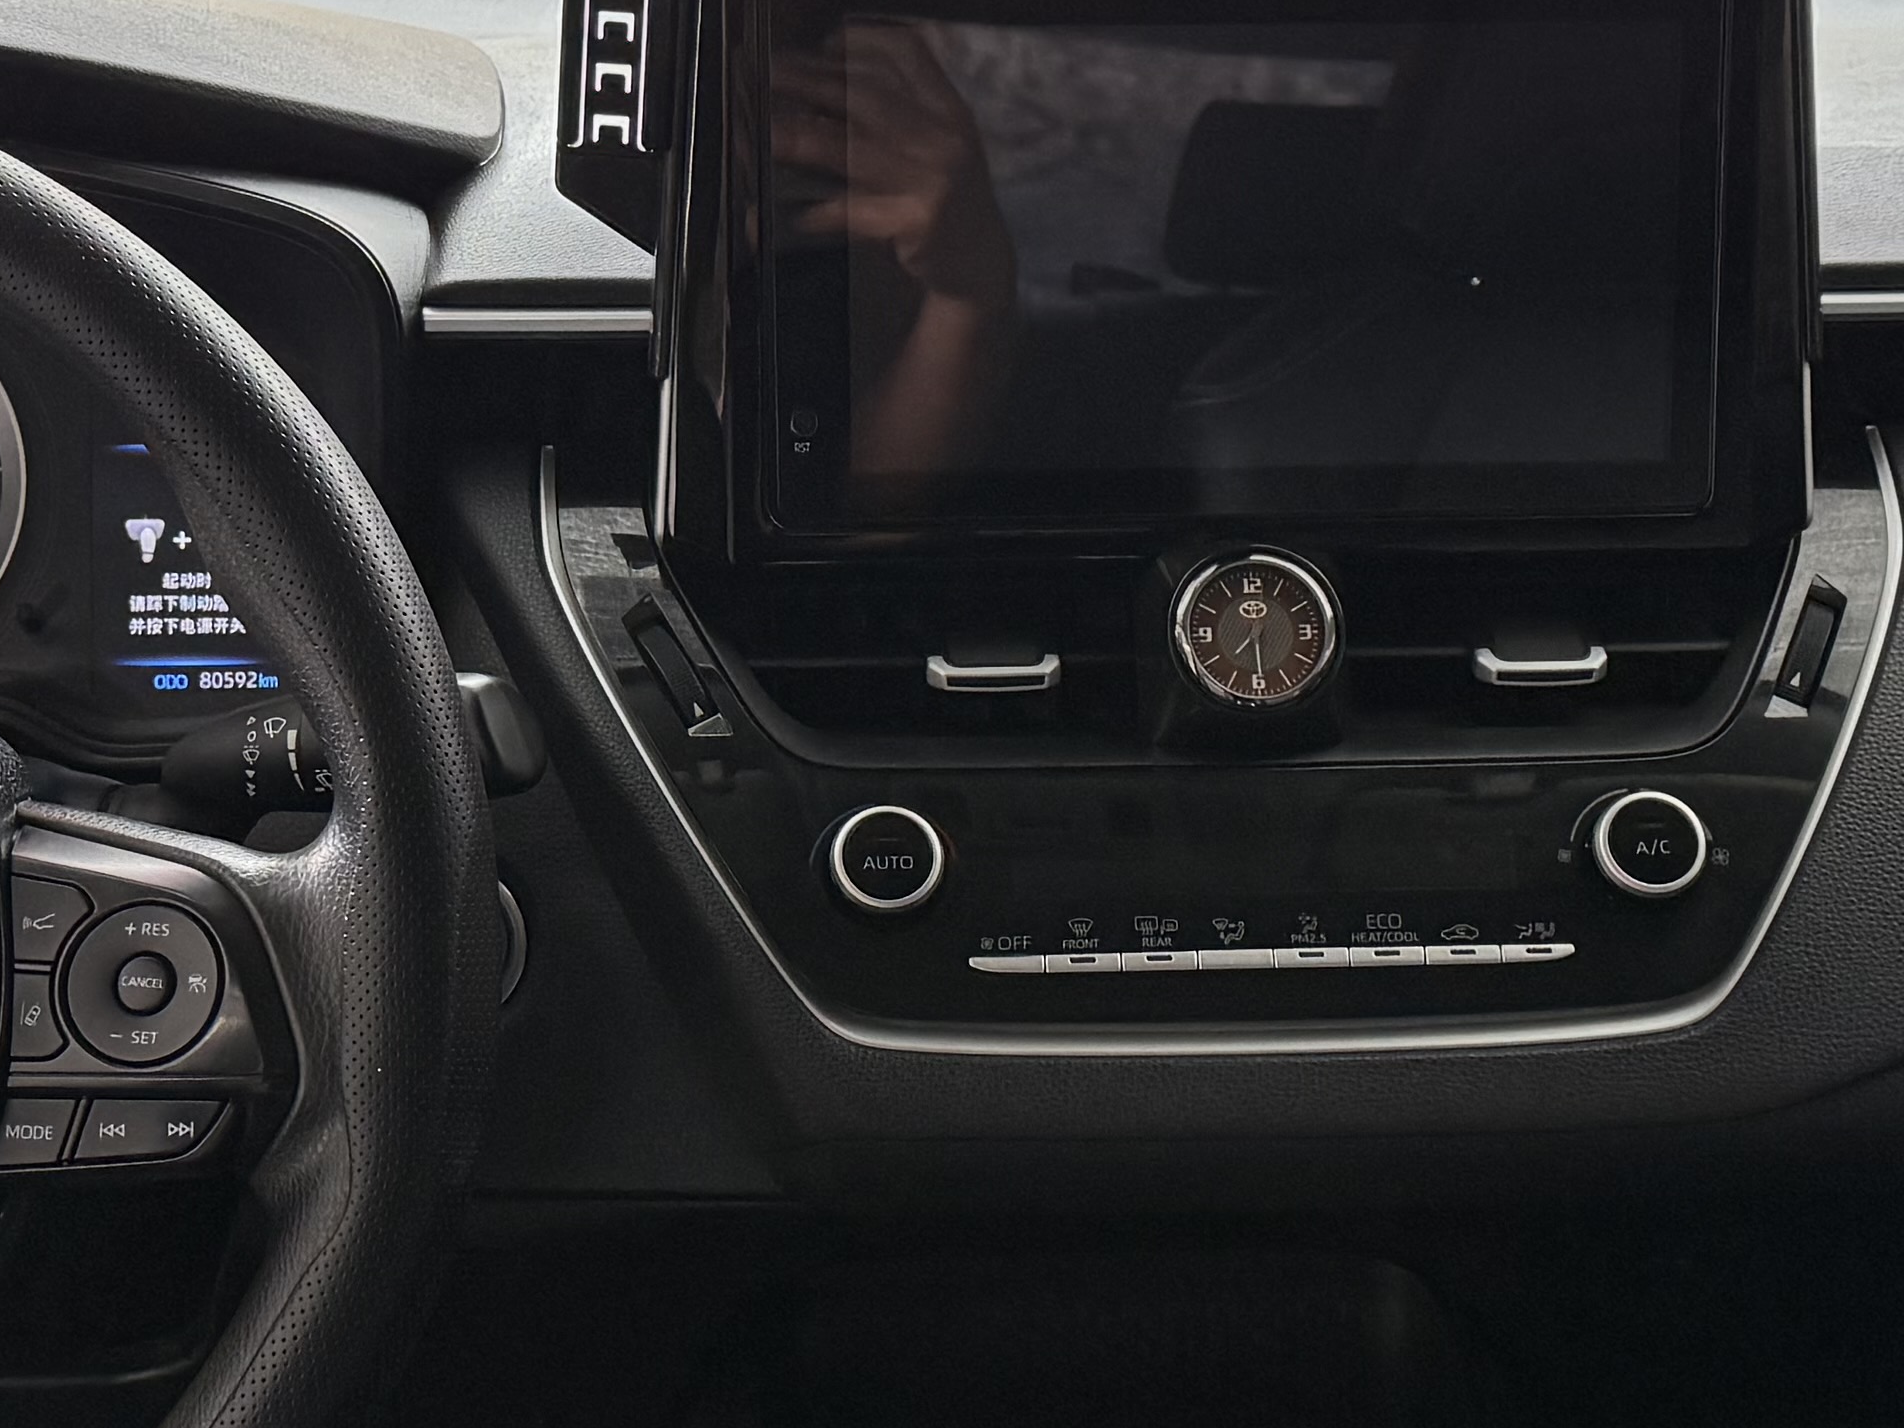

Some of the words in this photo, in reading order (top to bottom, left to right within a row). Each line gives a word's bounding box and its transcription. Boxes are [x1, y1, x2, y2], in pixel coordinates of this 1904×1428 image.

[161, 571, 212, 590] 起动时
[1242, 577, 1264, 594] 12
[1198, 627, 1213, 643] 9
[1298, 623, 1313, 641] 3
[153, 673, 189, 690] ODO
[1251, 673, 1266, 690] 6
[1636, 838, 1671, 857] A/C
[861, 853, 915, 872] AUTO
[141, 920, 171, 939] RES
[1365, 913, 1402, 930] ECO
[996, 935, 1033, 951] OFF
[1061, 937, 1100, 951] FRONT
[1141, 935, 1173, 948] REAR
[1290, 932, 1328, 945] PM2.5
[1351, 929, 1421, 944] HEAT/COOL
[120, 974, 165, 990] CANCEL
[130, 1029, 160, 1046] SET
[5, 1124, 54, 1141] MODE
